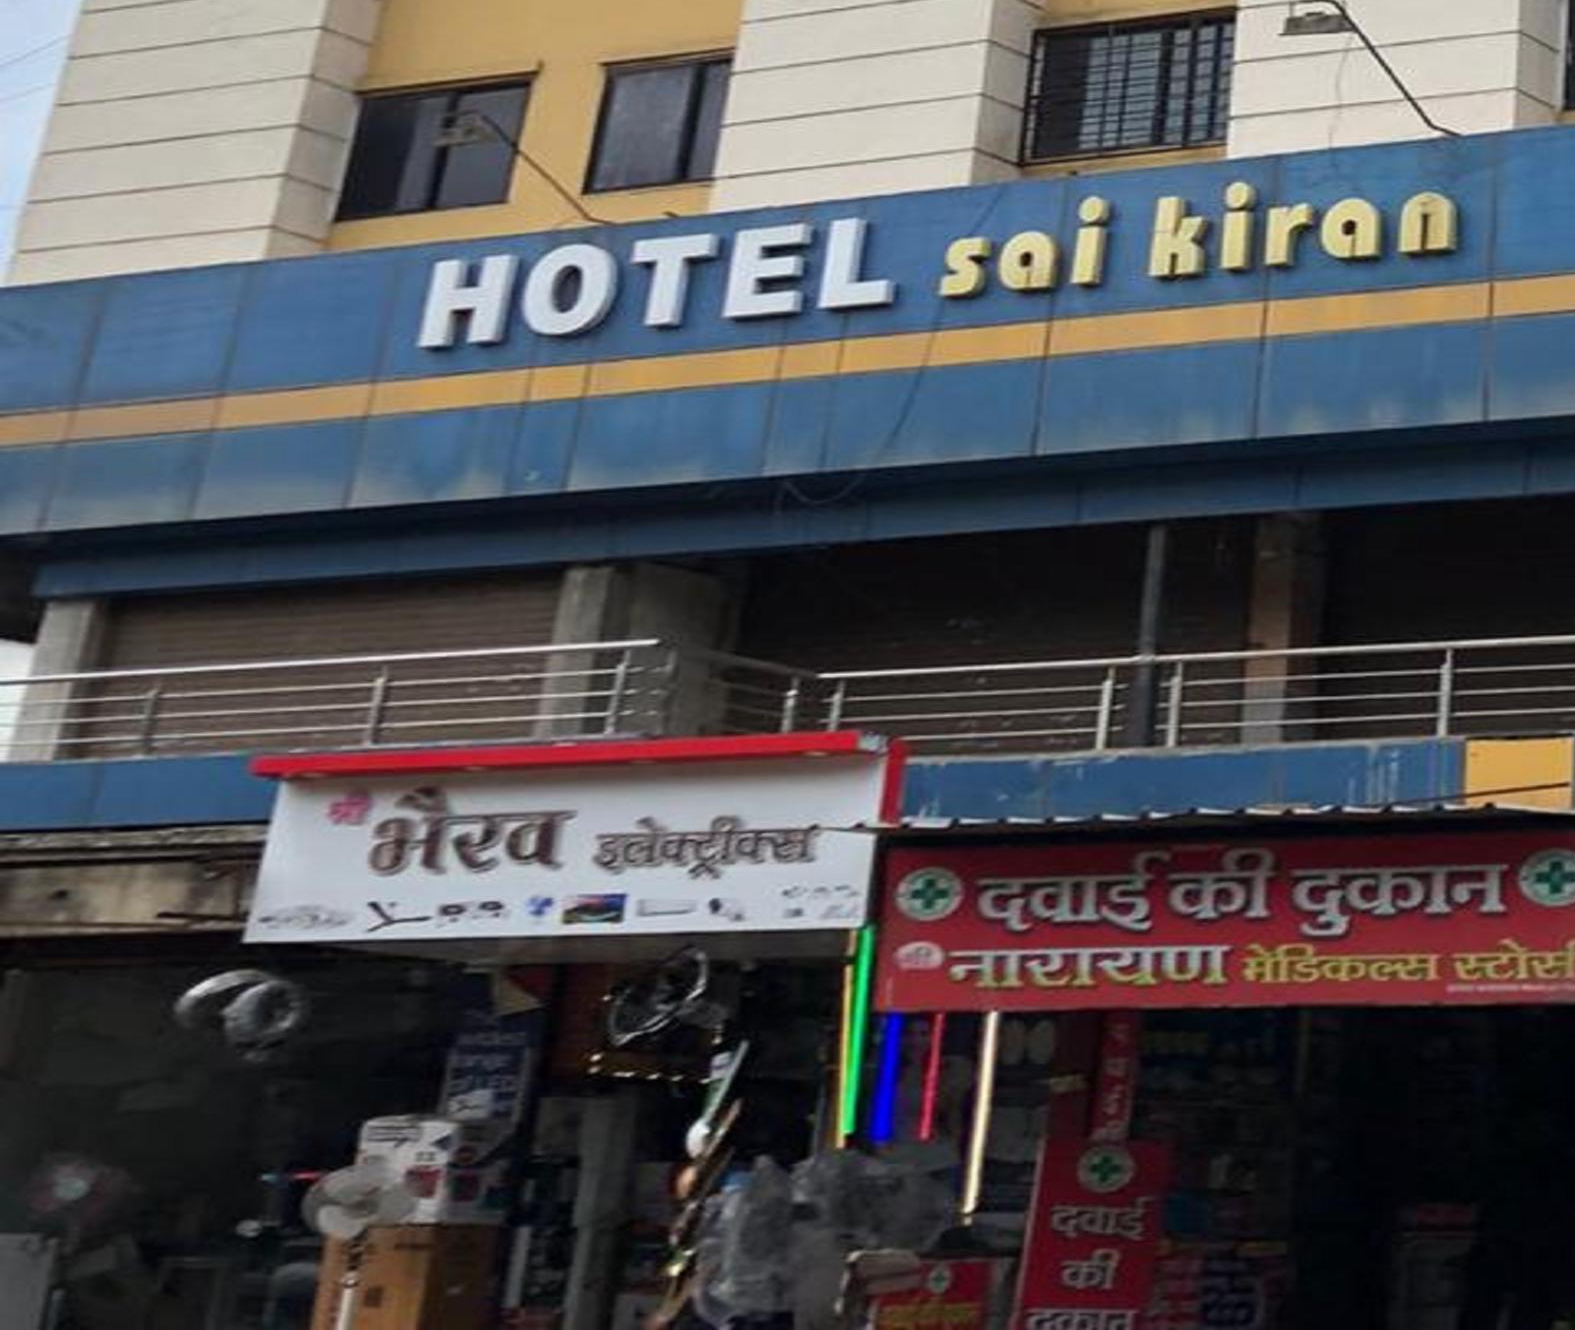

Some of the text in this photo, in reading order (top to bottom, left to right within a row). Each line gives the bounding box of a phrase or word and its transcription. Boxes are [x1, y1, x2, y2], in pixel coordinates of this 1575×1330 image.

[417, 181, 1458, 349] HOTEL sai kiran
[369, 786, 577, 875] भैरव
[977, 848, 1508, 936] दवाई की दुकान
[949, 944, 1231, 988] नारायण
[1050, 1196, 1153, 1241] दवाई
[1061, 1249, 1120, 1290] की
